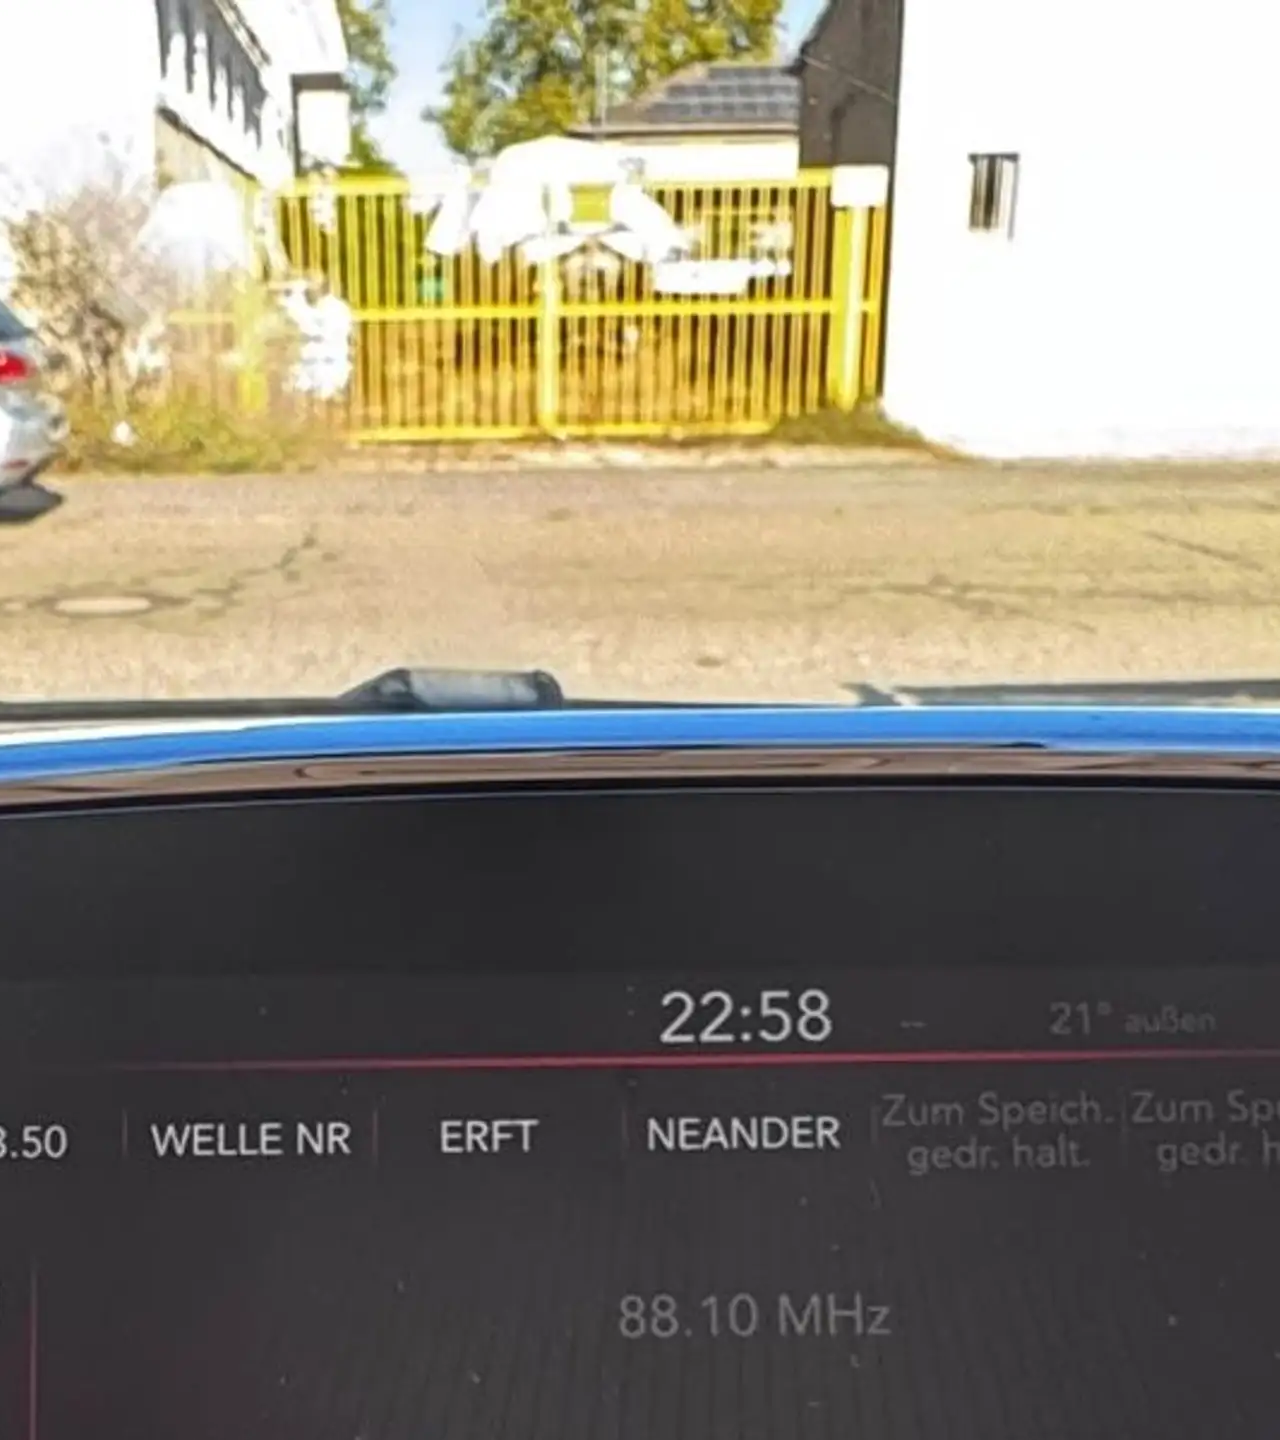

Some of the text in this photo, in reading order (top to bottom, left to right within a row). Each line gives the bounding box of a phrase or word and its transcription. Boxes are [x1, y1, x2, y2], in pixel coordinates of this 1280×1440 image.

[659, 989, 833, 1044] 22:58
[1048, 1002, 1216, 1037] 21° außen
[881, 1090, 1113, 1135] Zum Speich.
[1130, 1091, 1213, 1125] Zum
[150, 1122, 352, 1157] WELLE NR
[439, 1118, 539, 1154] ERFT
[646, 1115, 841, 1151] NEANDER
[906, 1135, 1090, 1175] gedr. halt.
[1156, 1135, 1249, 1172] gedr.
[619, 1291, 892, 1338] 88.10 MHz
